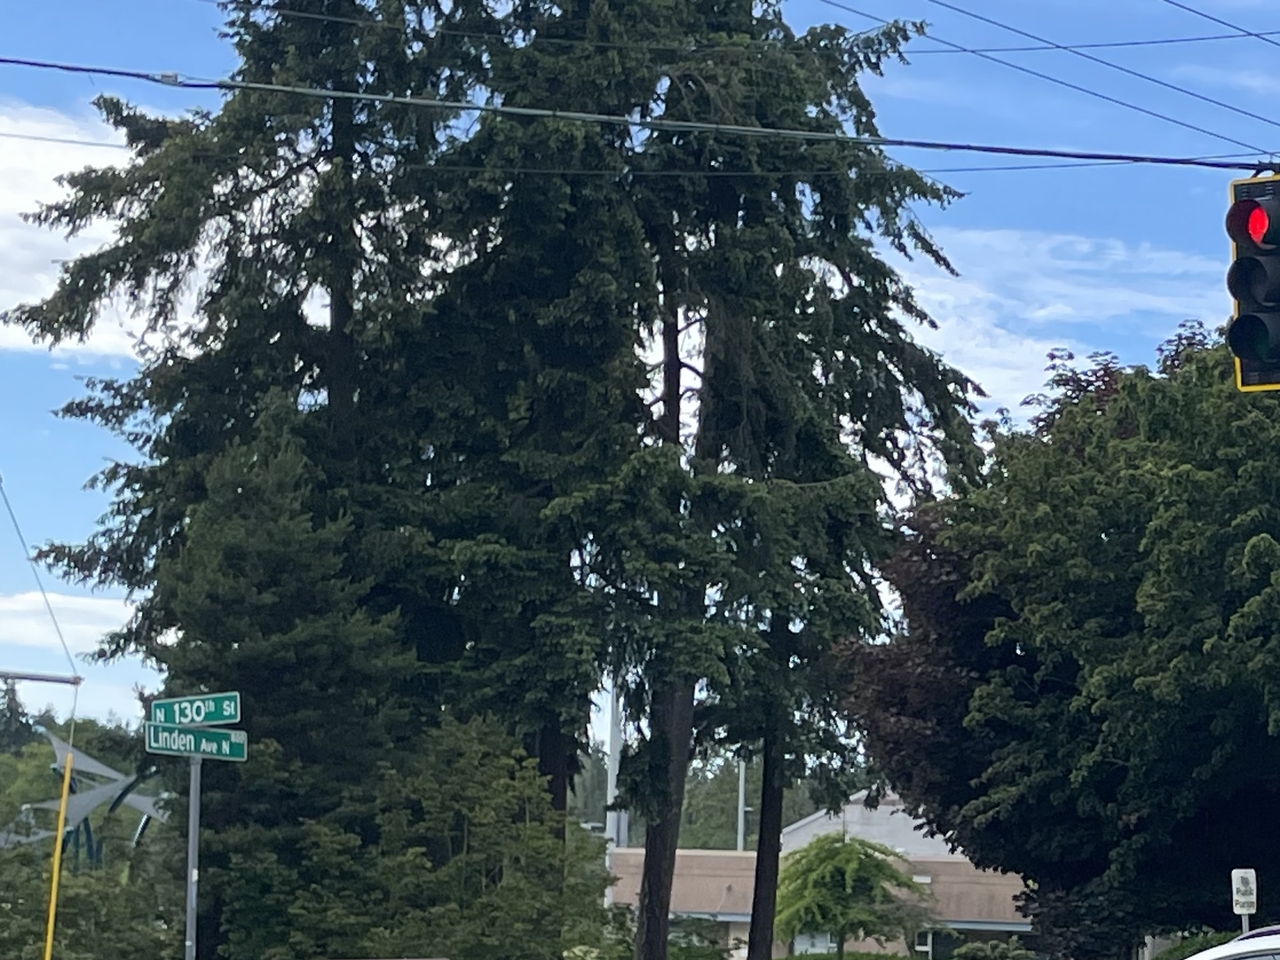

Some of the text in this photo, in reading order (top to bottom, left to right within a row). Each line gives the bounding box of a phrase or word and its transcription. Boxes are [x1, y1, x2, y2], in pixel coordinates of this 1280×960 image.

[155, 700, 235, 723] N 130th St
[149, 726, 230, 754] Linden Ave N
